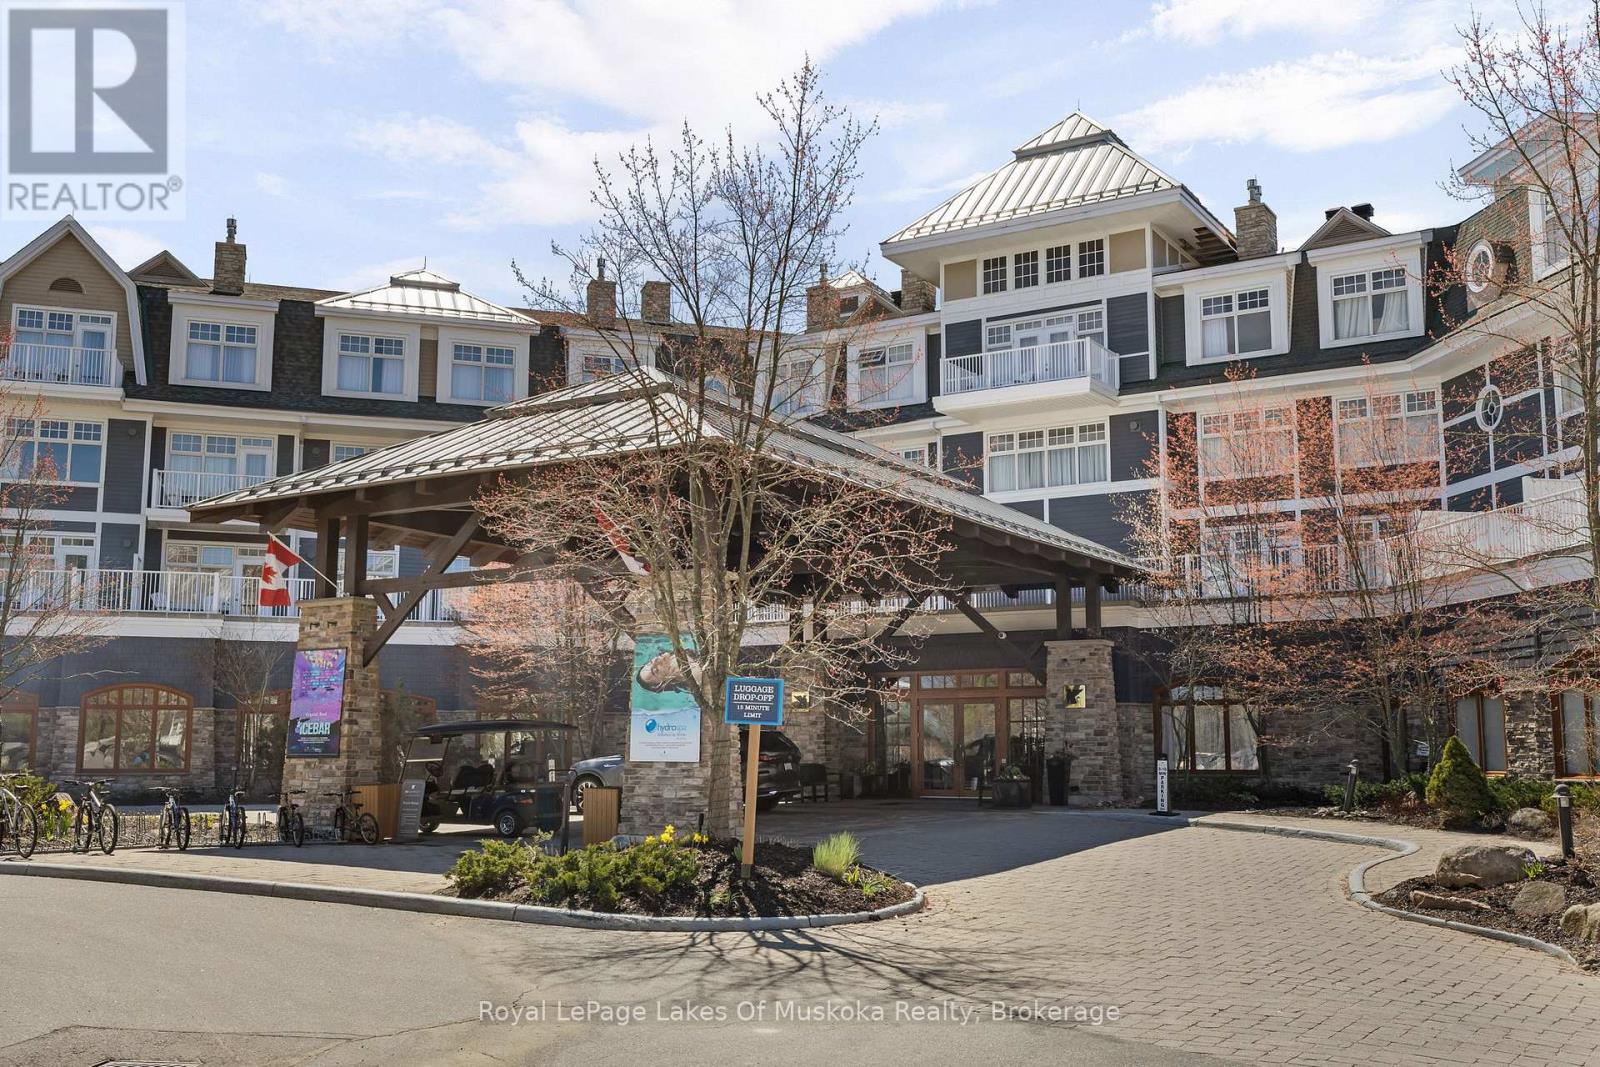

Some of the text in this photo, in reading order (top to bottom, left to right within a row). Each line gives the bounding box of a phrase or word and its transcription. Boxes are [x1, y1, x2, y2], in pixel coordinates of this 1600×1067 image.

[734, 685, 774, 693] LUGGAGE
[733, 693, 775, 701] DROP-OFF
[299, 721, 331, 735] ICEBAR
